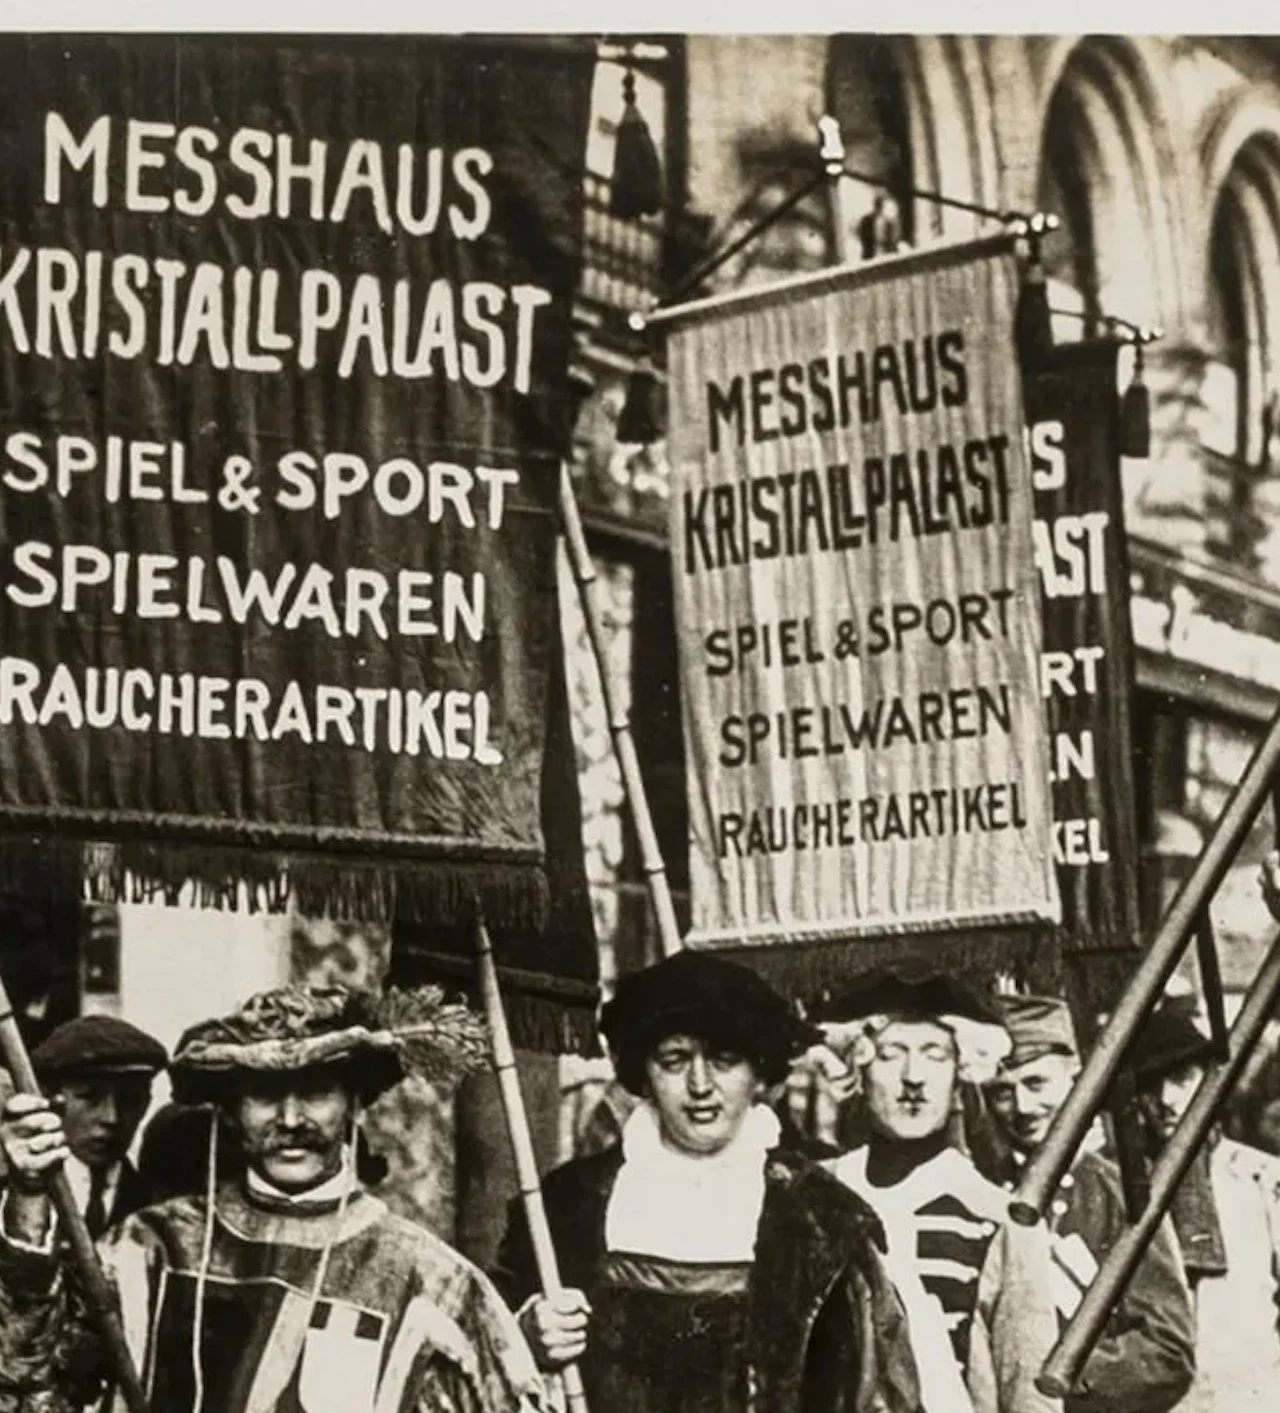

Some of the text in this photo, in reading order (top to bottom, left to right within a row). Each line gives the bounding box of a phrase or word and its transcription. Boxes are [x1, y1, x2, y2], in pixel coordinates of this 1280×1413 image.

[44, 111, 495, 241] MESSHAUS
[706, 330, 968, 453] MESSHAUS
[2, 431, 521, 531] SPIEL & SPORT
[683, 434, 1010, 575] KRISTALLPALAST
[5, 540, 486, 644] SPIELWAREN
[705, 589, 1014, 678] SPIEL & SPORT
[719, 684, 1012, 768] SPIELWAREN
[719, 782, 1026, 857] RAUCHERARTIKEL
